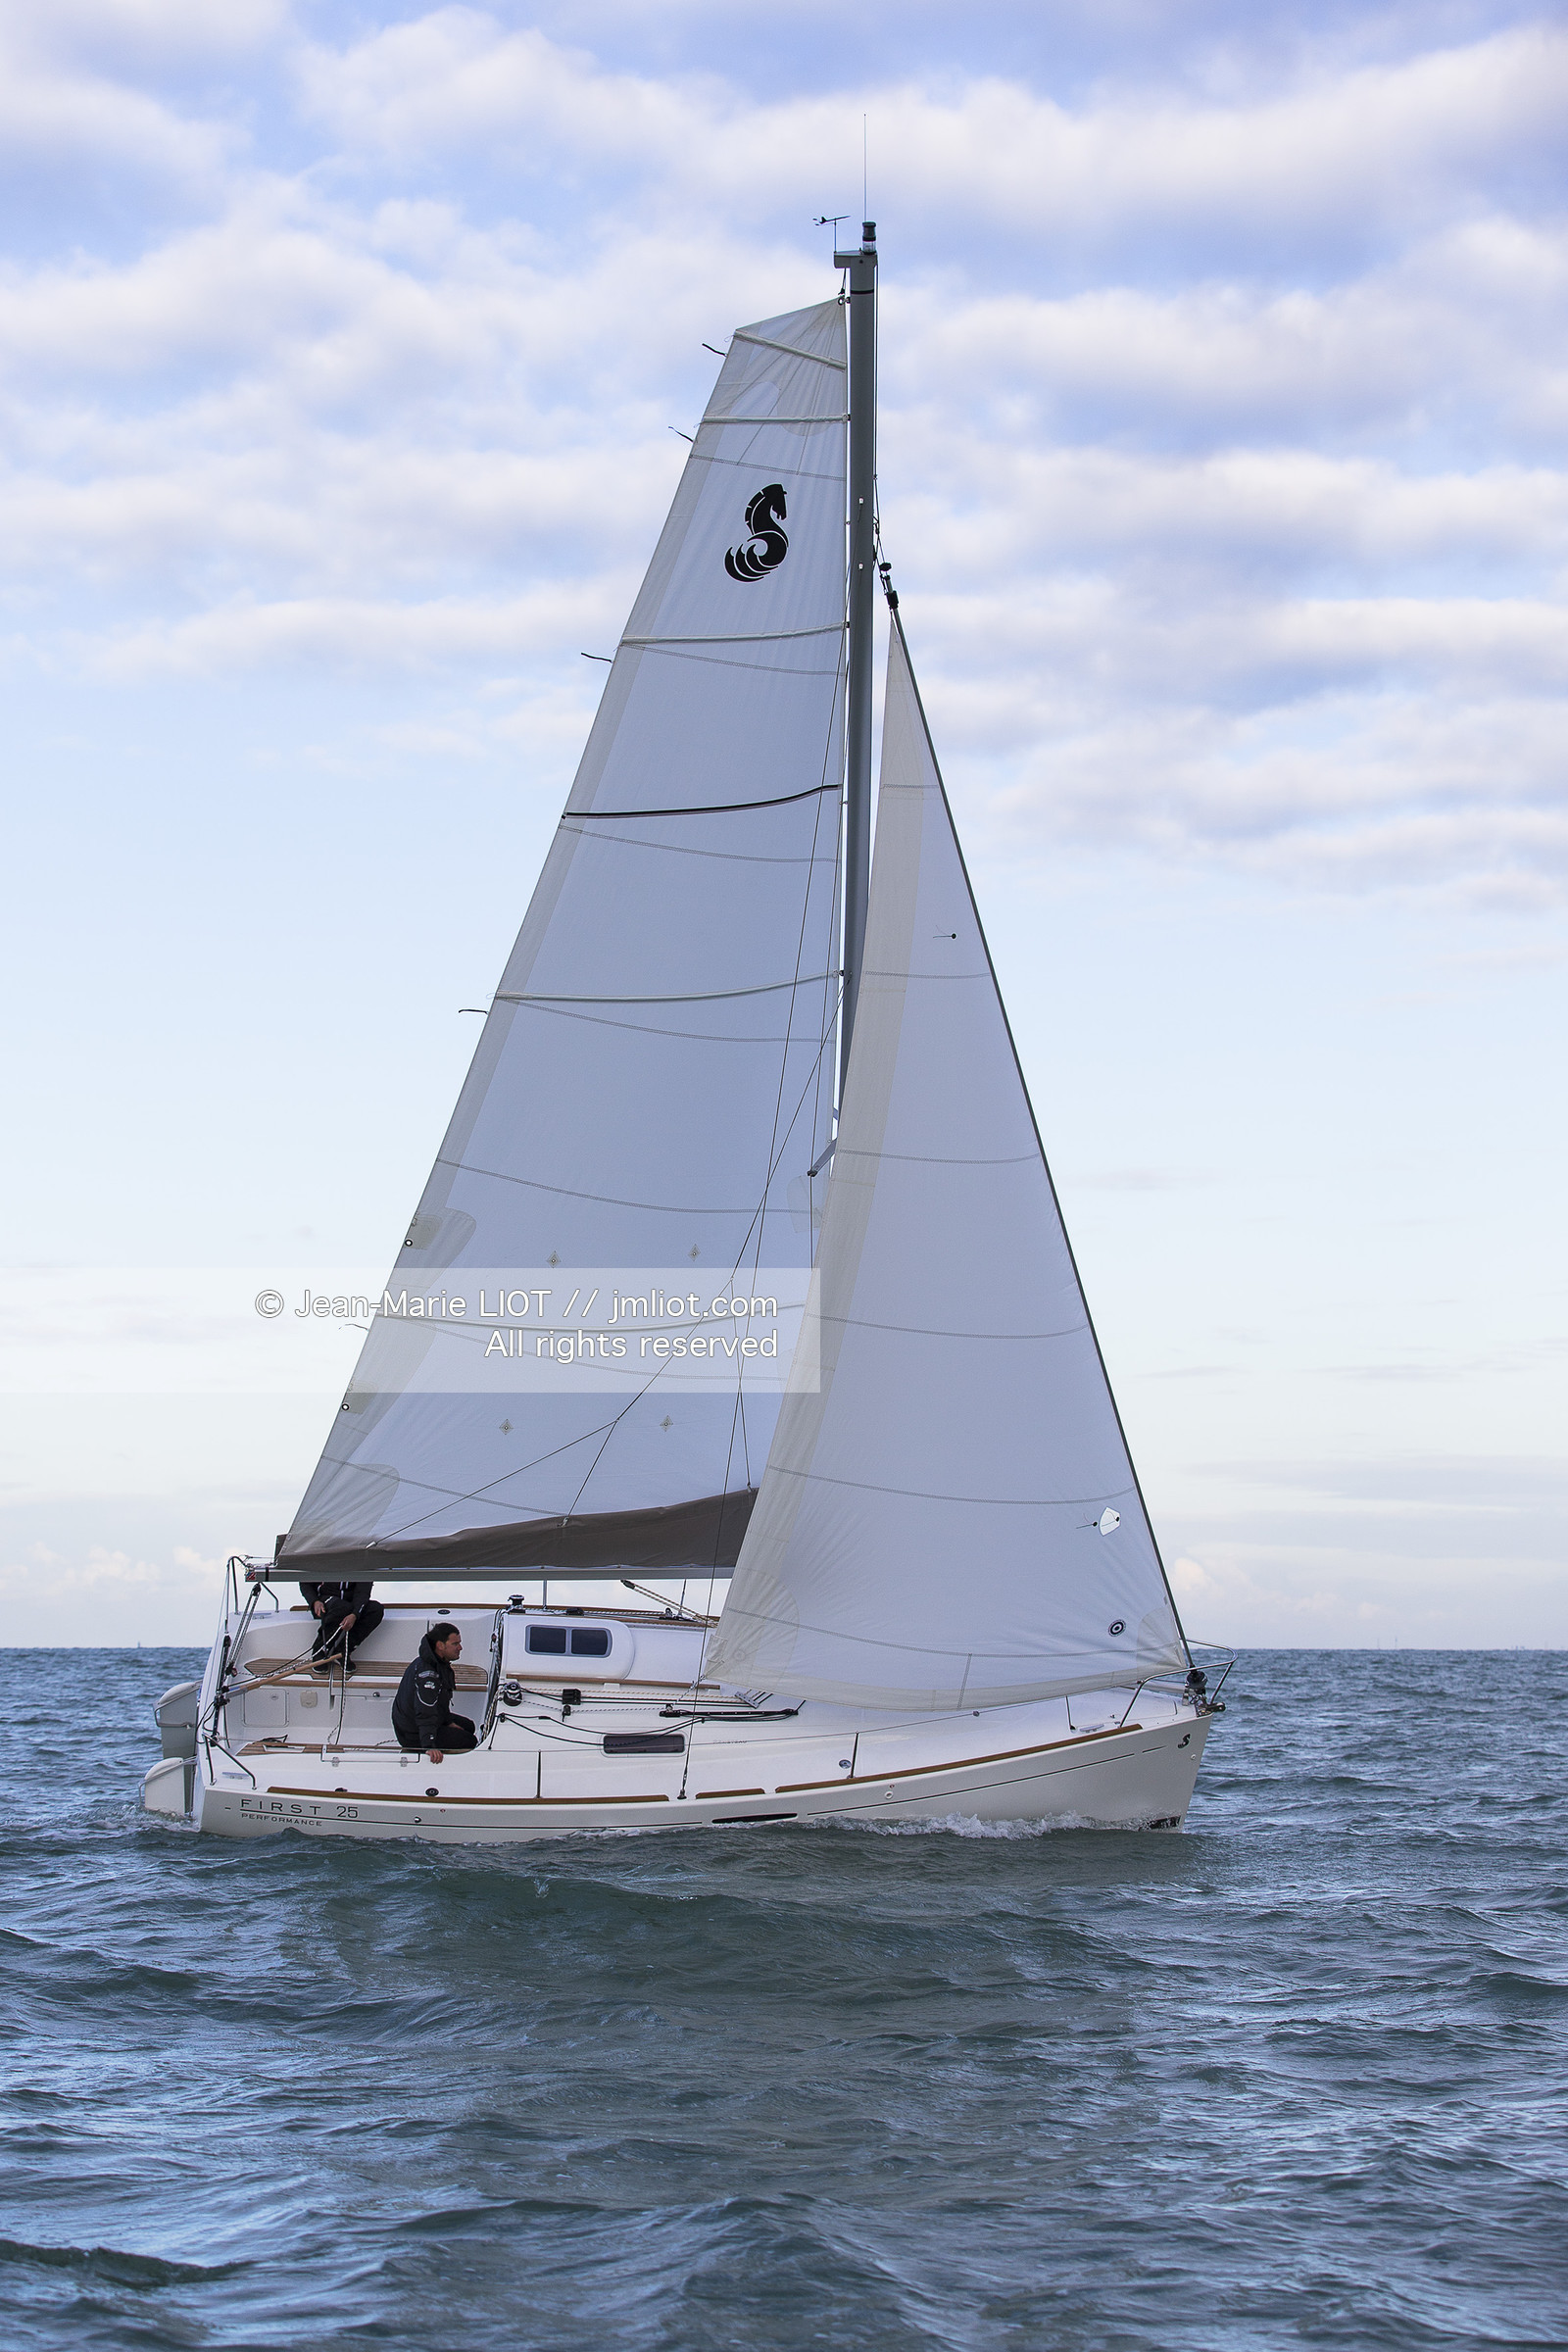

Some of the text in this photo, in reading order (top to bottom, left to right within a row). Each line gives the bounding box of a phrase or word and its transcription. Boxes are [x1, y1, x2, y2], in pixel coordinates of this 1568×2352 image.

[241, 1798, 358, 1818] FIRST 25
[241, 1812, 322, 1827] PERFORMANCE
